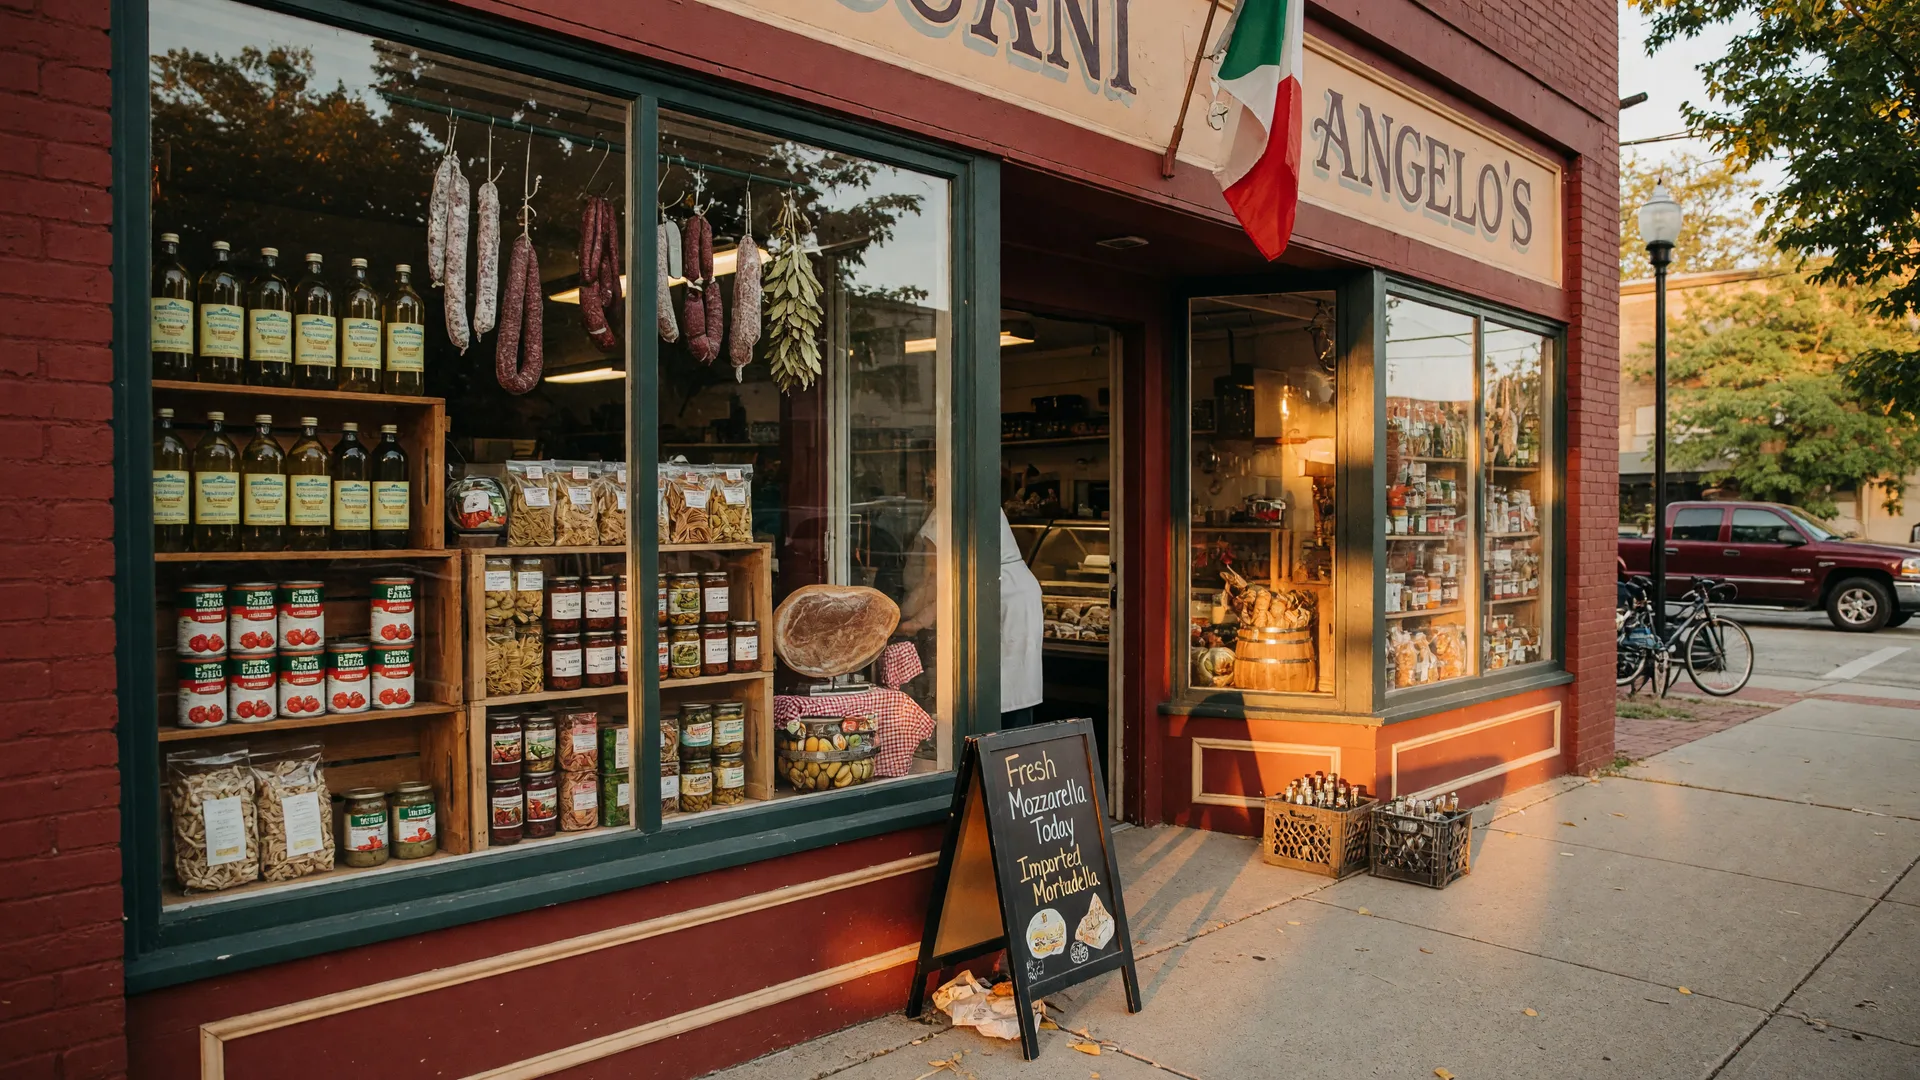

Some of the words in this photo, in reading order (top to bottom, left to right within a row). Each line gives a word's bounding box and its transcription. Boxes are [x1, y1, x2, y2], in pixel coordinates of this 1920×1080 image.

[1313, 87, 1532, 248] ANGELO'S
[1004, 750, 1057, 788] Fresh
[1007, 778, 1087, 820] Mozzarella
[1030, 814, 1075, 847] Today
[1016, 843, 1082, 884] Imported
[1032, 866, 1101, 906] Mortadella
